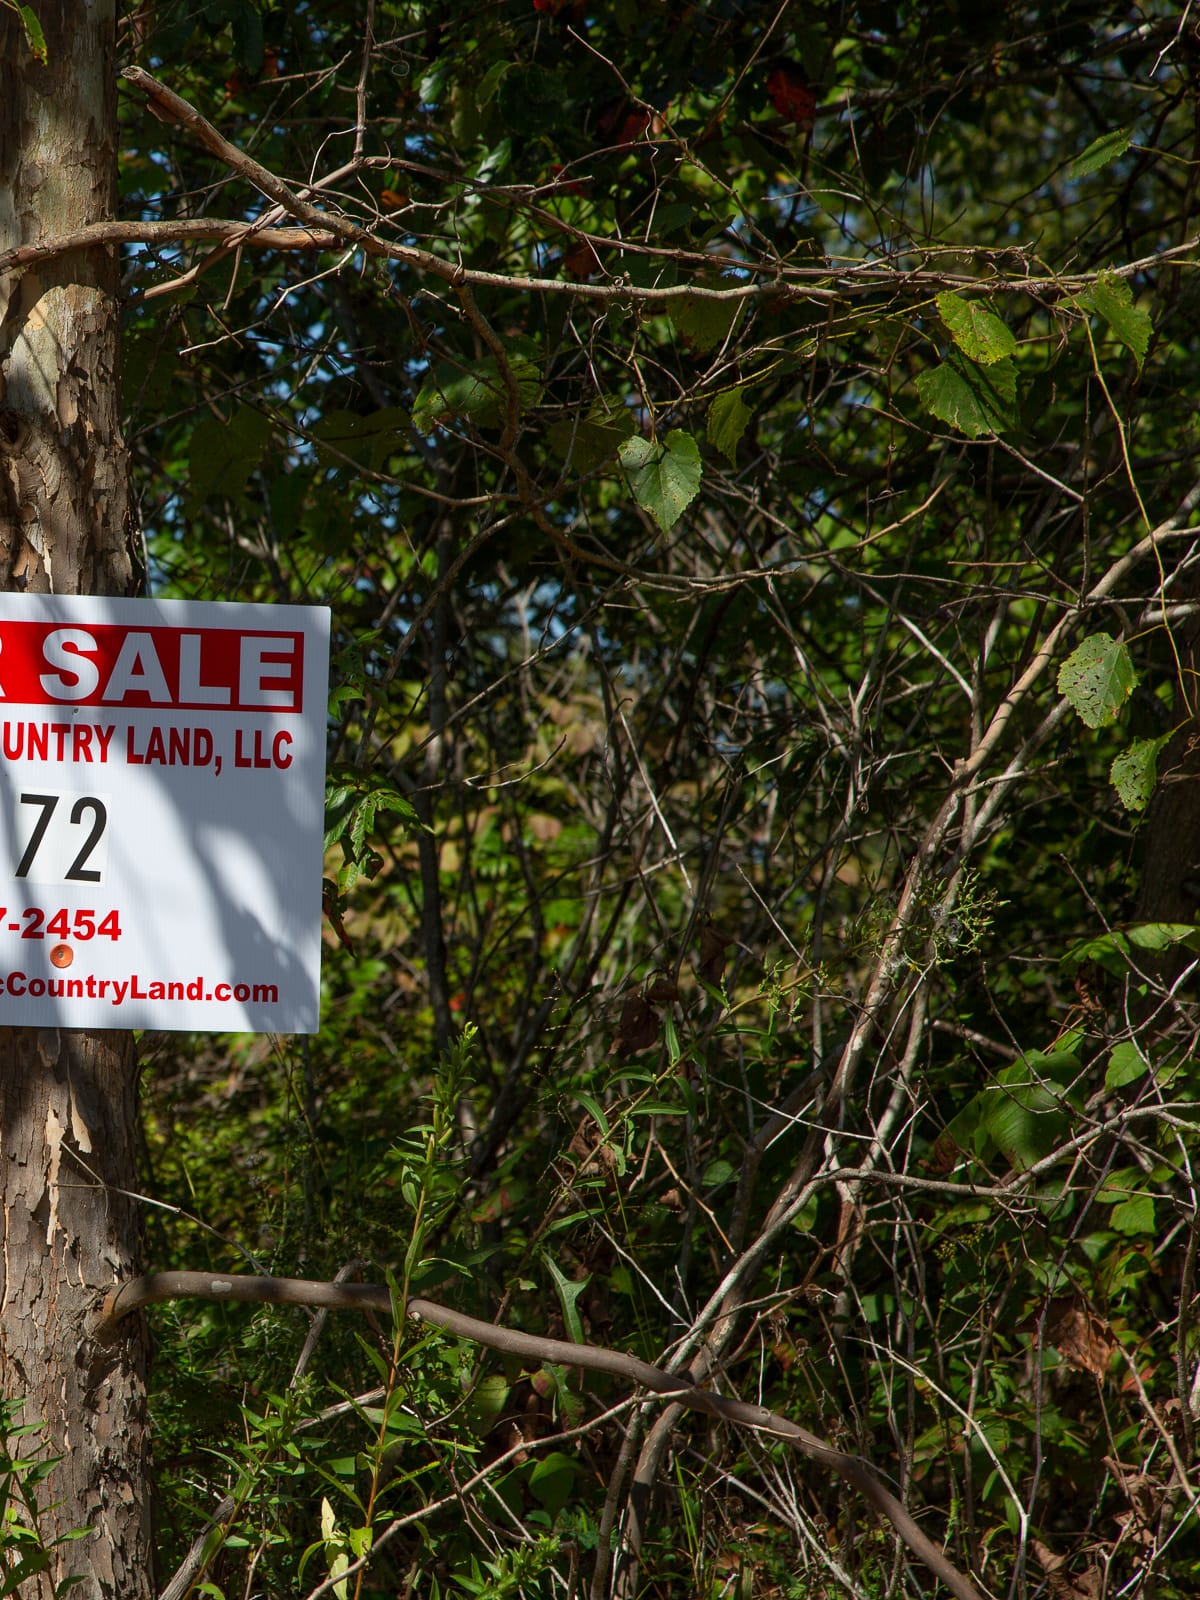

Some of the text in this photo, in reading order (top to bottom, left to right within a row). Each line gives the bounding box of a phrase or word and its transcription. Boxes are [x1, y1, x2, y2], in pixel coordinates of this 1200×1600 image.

[40, 628, 296, 708] SALE
[126, 726, 223, 776] LAND,
[234, 730, 294, 770] LLC
[14, 793, 109, 883] 72
